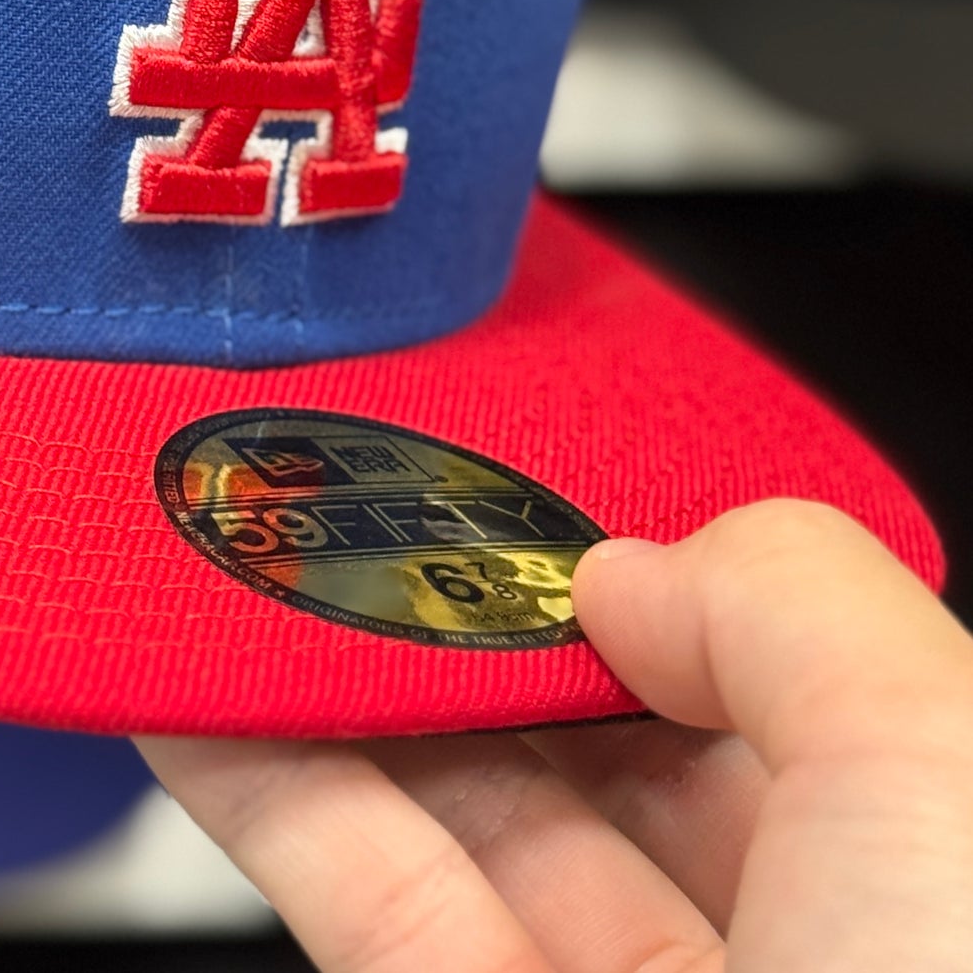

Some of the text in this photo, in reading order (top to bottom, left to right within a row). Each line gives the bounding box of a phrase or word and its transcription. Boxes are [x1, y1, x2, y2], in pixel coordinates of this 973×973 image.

[329, 445, 394, 461] NEW
[346, 459, 411, 473] ERA
[210, 500, 546, 554] 59FIFTY
[421, 562, 485, 604] 6
[291, 594, 405, 635] ORIGINATORS
[438, 632, 469, 645] THE
[472, 635, 514, 646] TRUE
[513, 629, 564, 645] FITTED
